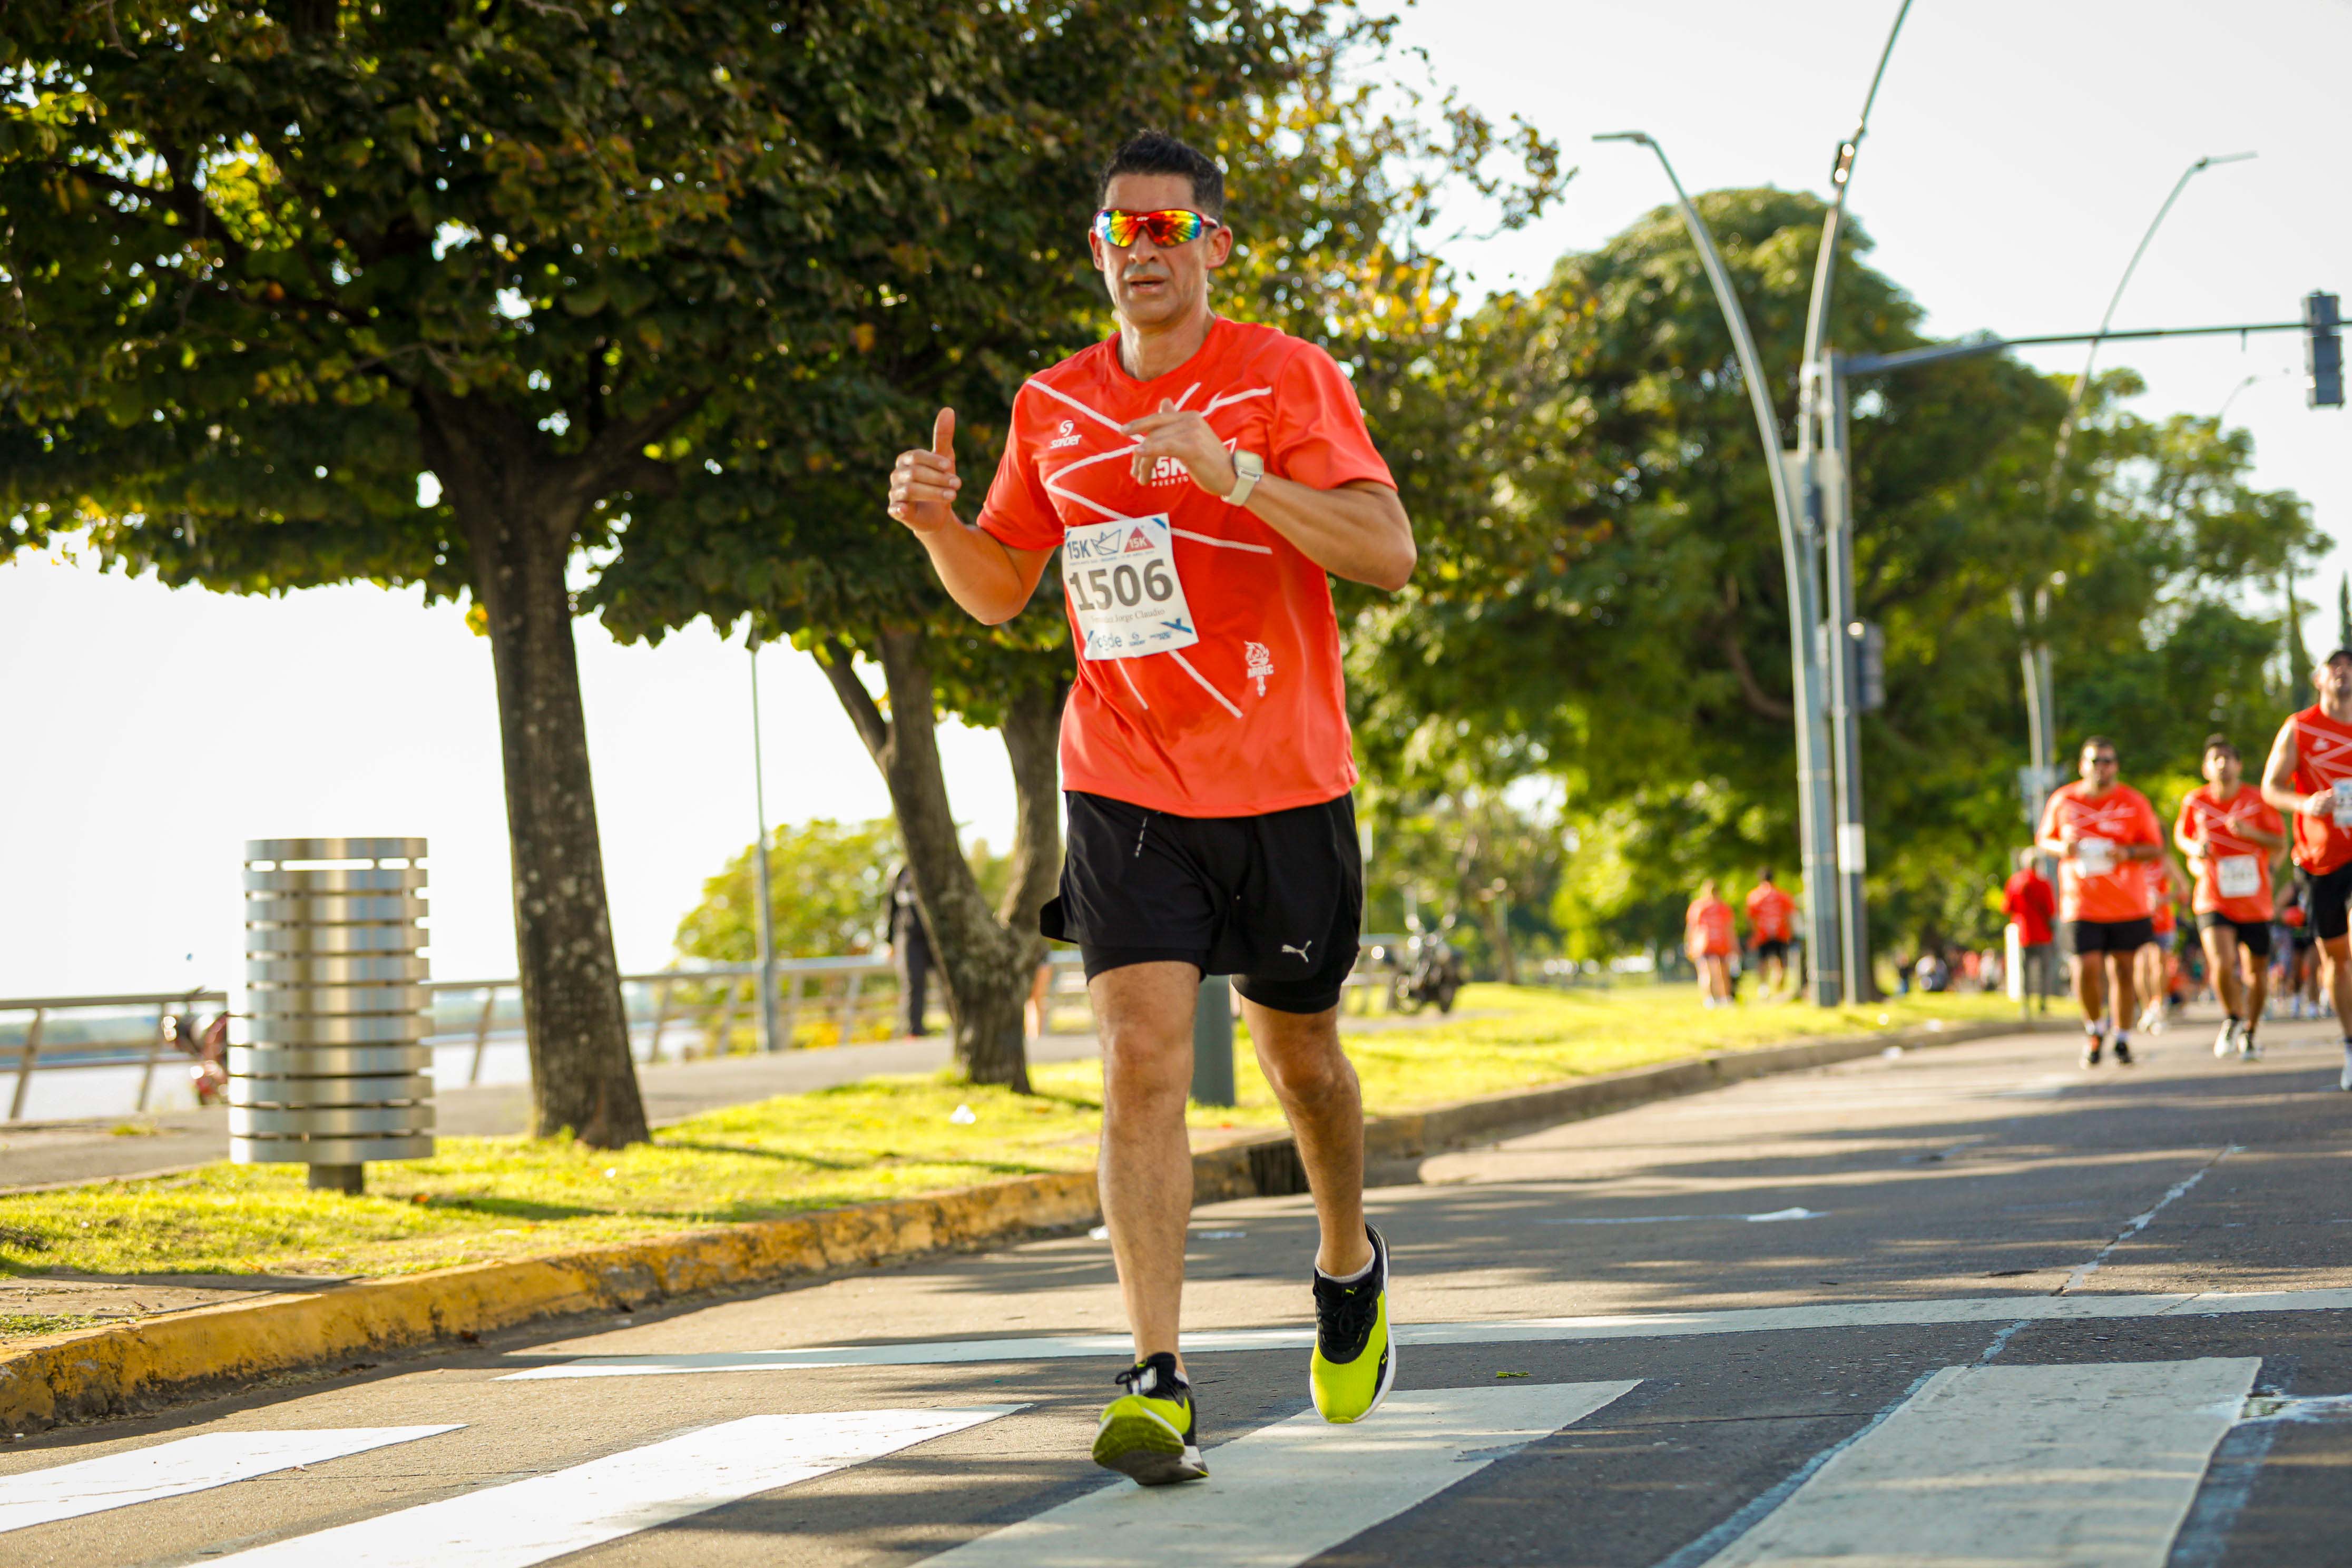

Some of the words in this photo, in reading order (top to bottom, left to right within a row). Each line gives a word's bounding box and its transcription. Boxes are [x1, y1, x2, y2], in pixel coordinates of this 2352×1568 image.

[1151, 476, 1189, 487] PUERTO
[1067, 540, 1091, 560] 15K
[1129, 537, 1148, 548] 15K
[1069, 559, 1173, 611] 1506
[1115, 614, 1133, 623] Jorge
[1135, 608, 1165, 619] Claudio
